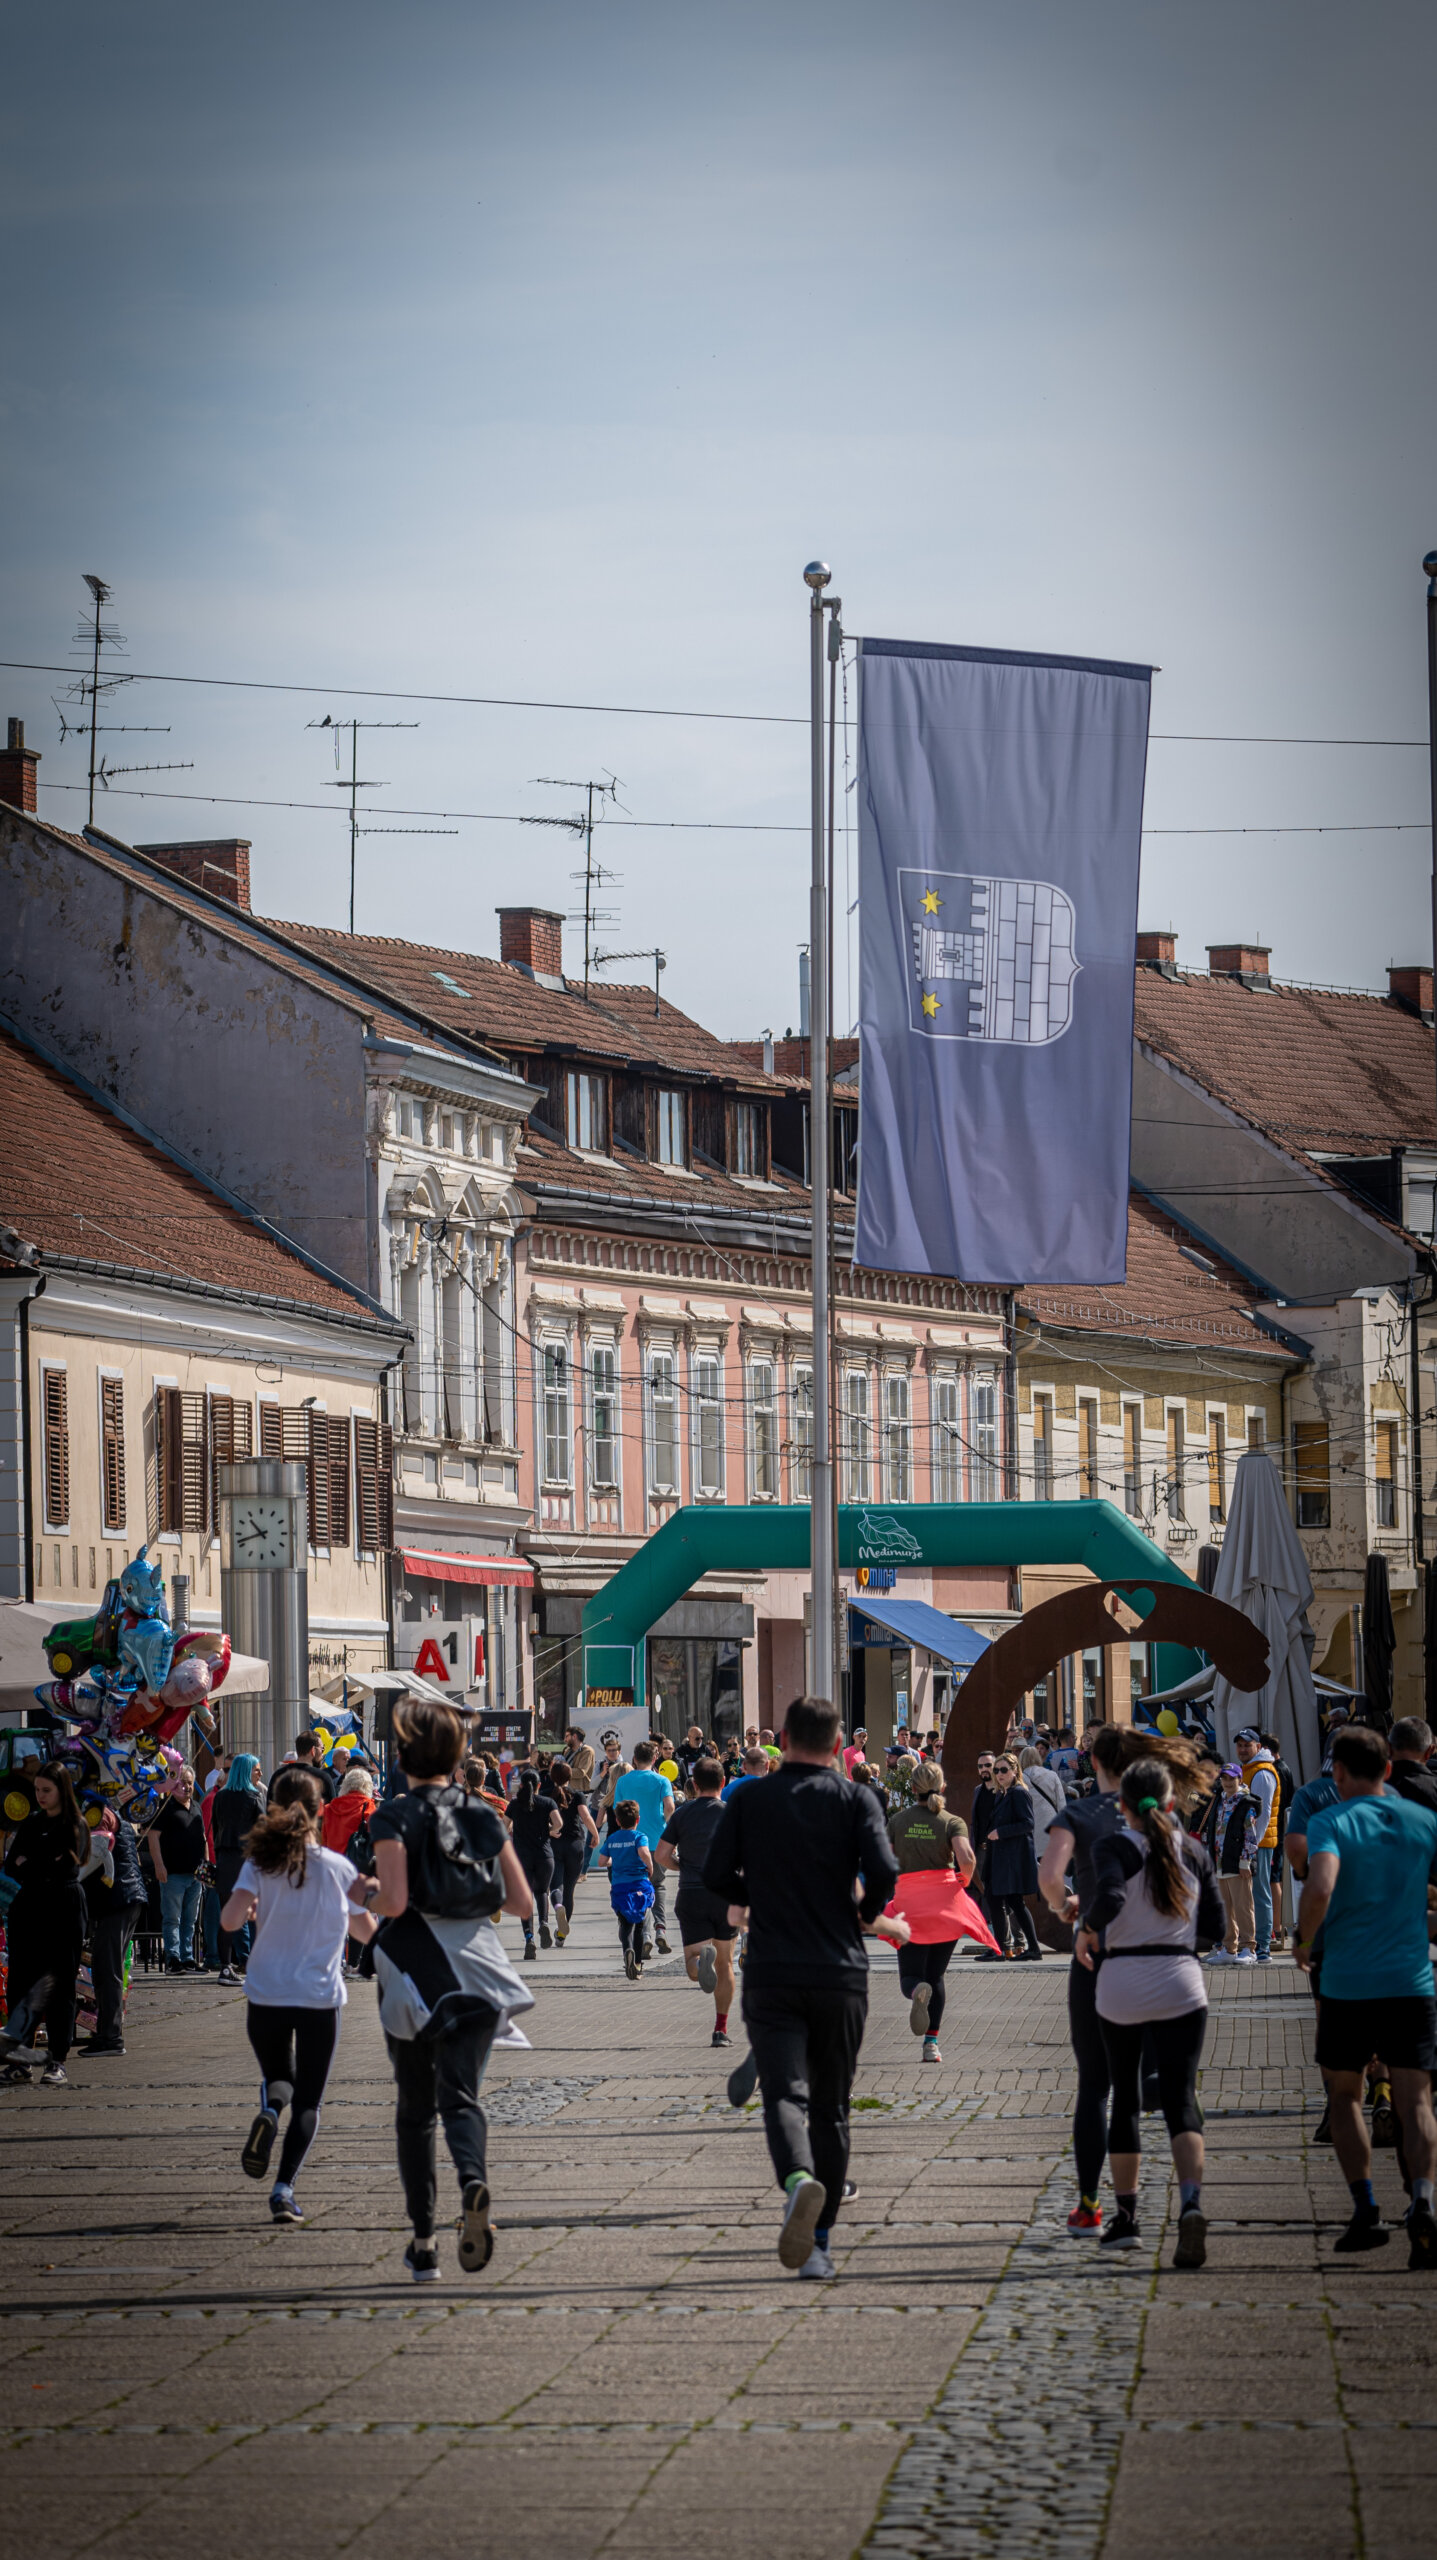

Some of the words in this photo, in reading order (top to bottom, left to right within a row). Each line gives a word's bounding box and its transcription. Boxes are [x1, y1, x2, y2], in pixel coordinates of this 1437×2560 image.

[869, 1567, 897, 1587] mlinar
[414, 1631, 457, 1682] A1
[595, 1690, 623, 1703] POLU
